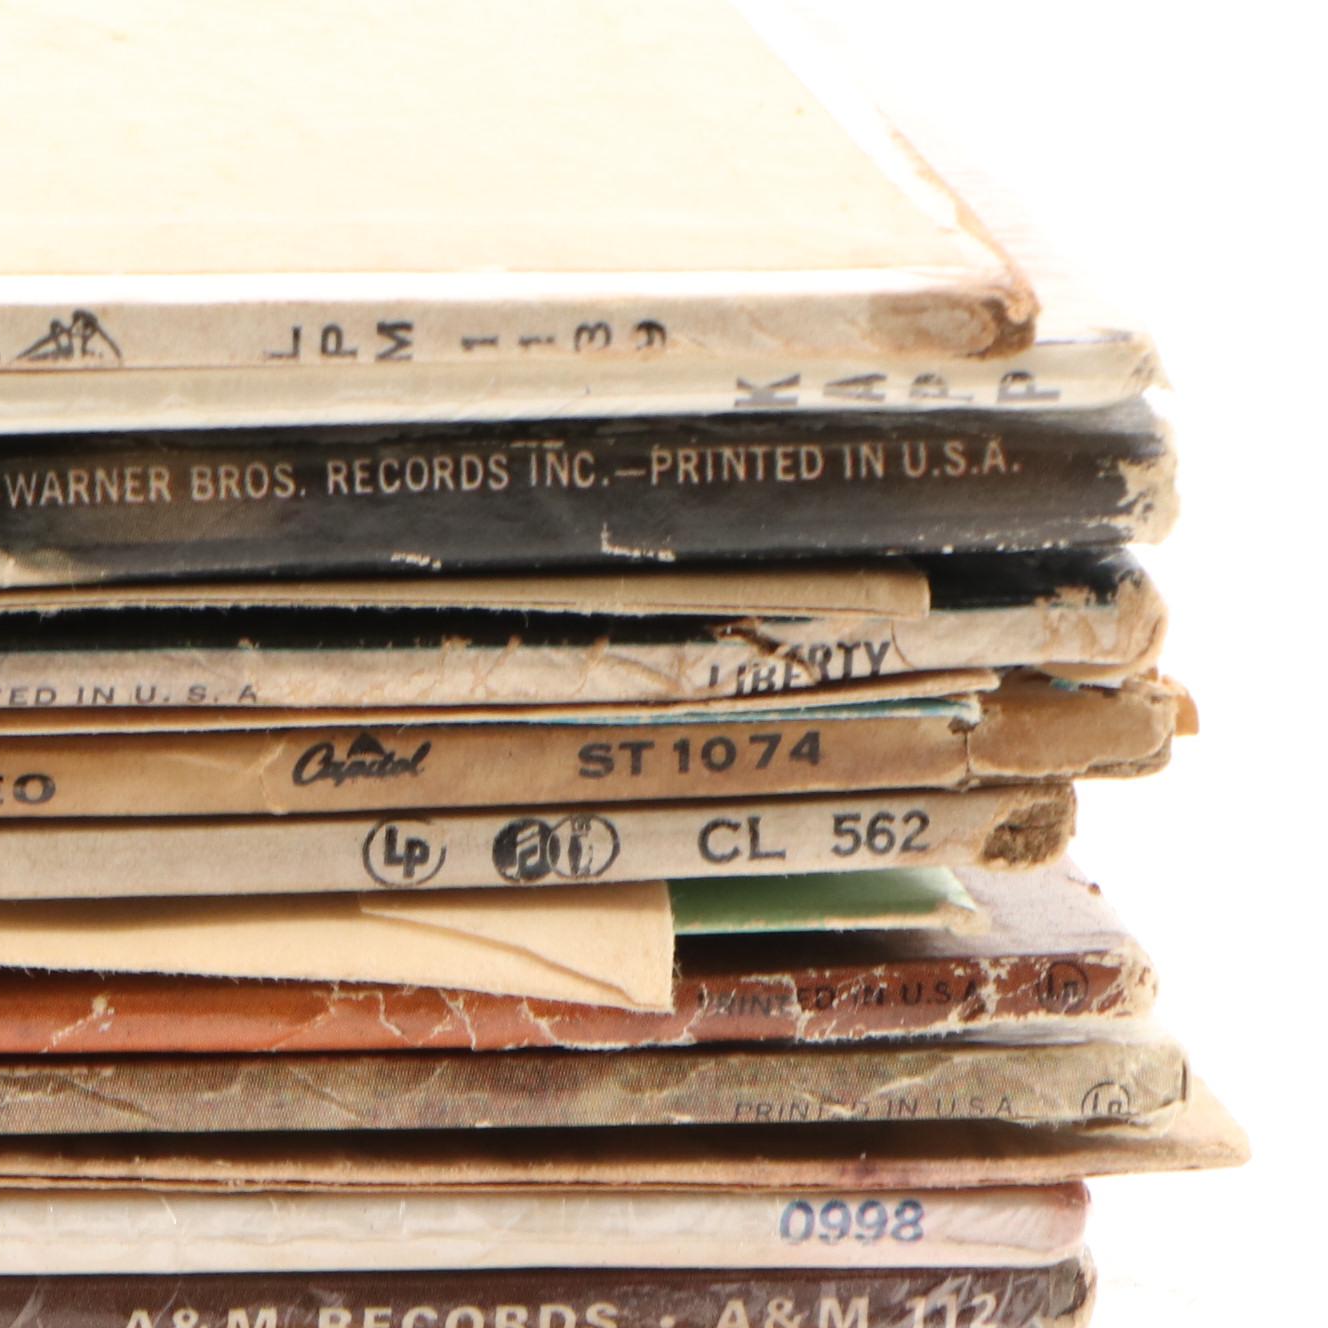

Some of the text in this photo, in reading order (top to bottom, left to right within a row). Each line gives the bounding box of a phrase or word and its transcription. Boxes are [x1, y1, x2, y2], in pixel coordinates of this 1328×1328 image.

[263, 319, 668, 362] LPM 1139
[190, 461, 307, 502] BROS.
[327, 452, 509, 496] RECORDS
[844, 442, 885, 480] IN
[903, 440, 1020, 478] U.S.A.
[79, 685, 115, 706] IN
[698, 810, 932, 862] CL 562
[779, 1199, 924, 1245] 0998
